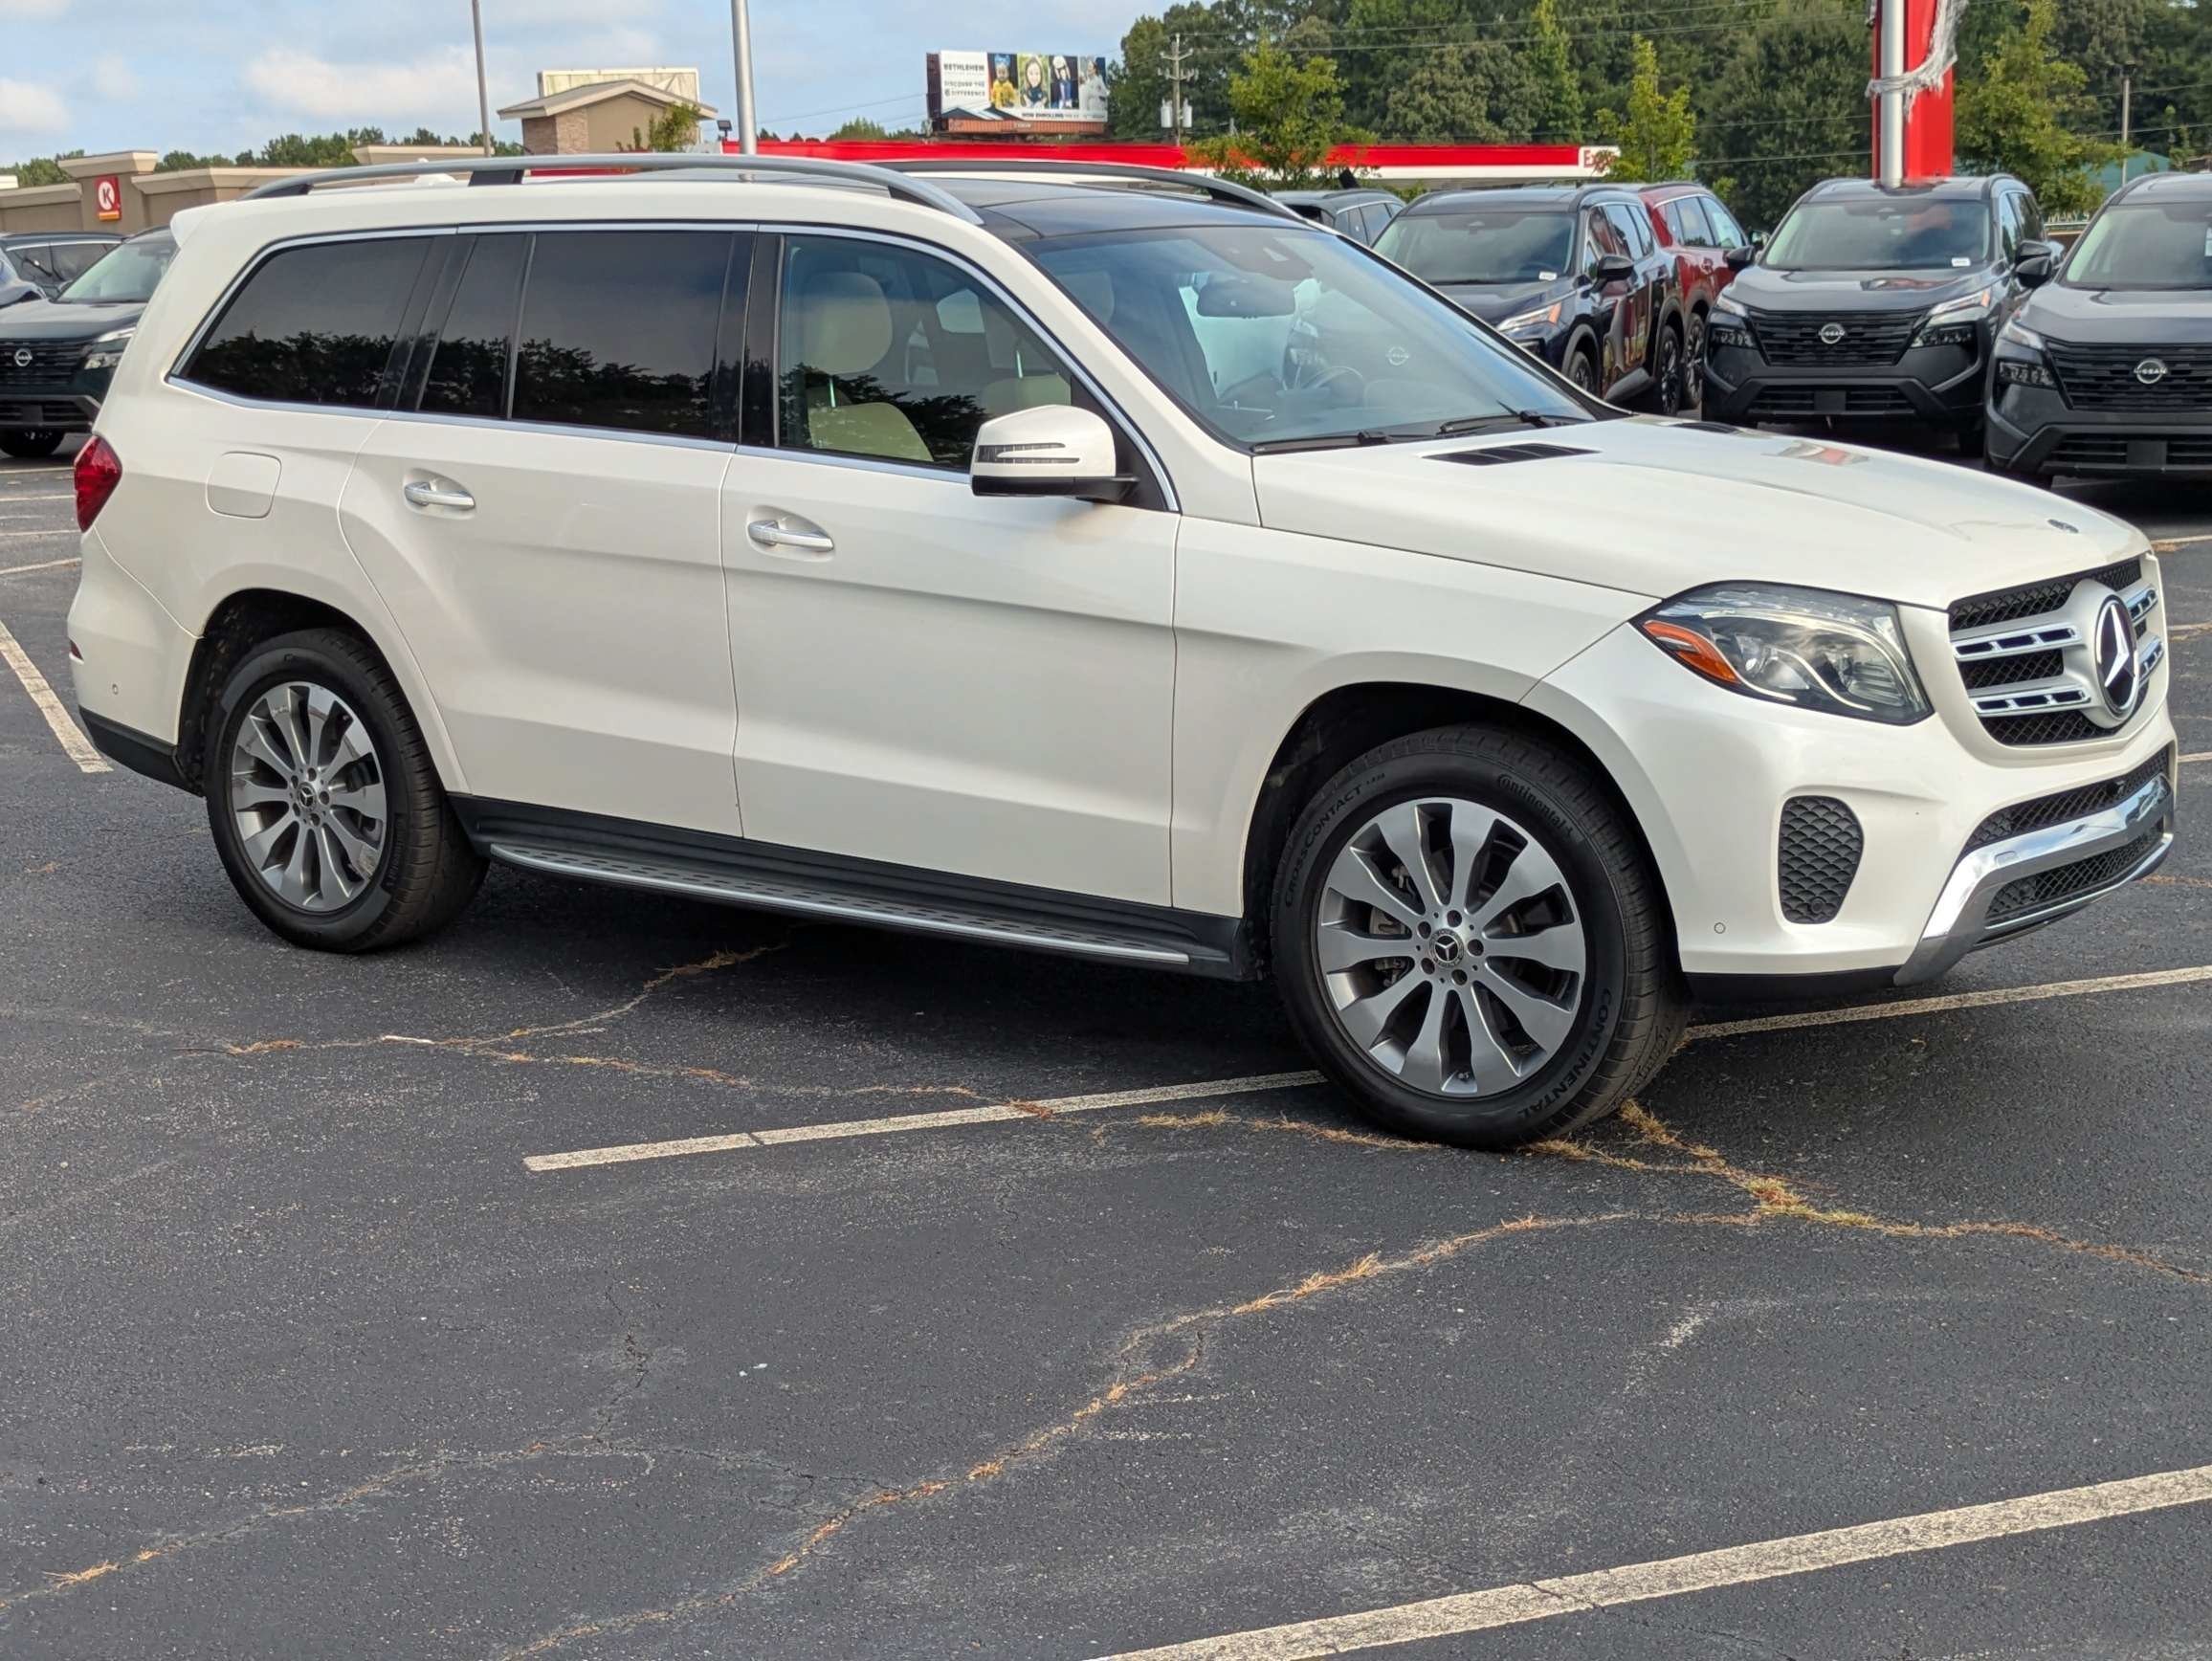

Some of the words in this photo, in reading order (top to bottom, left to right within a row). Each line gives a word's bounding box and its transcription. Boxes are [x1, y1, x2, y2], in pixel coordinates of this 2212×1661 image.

[943, 63, 985, 72] BETHLEHEM
[1497, 773, 1567, 830] Continental
[1516, 987, 1613, 1119] CONTINENTAL
